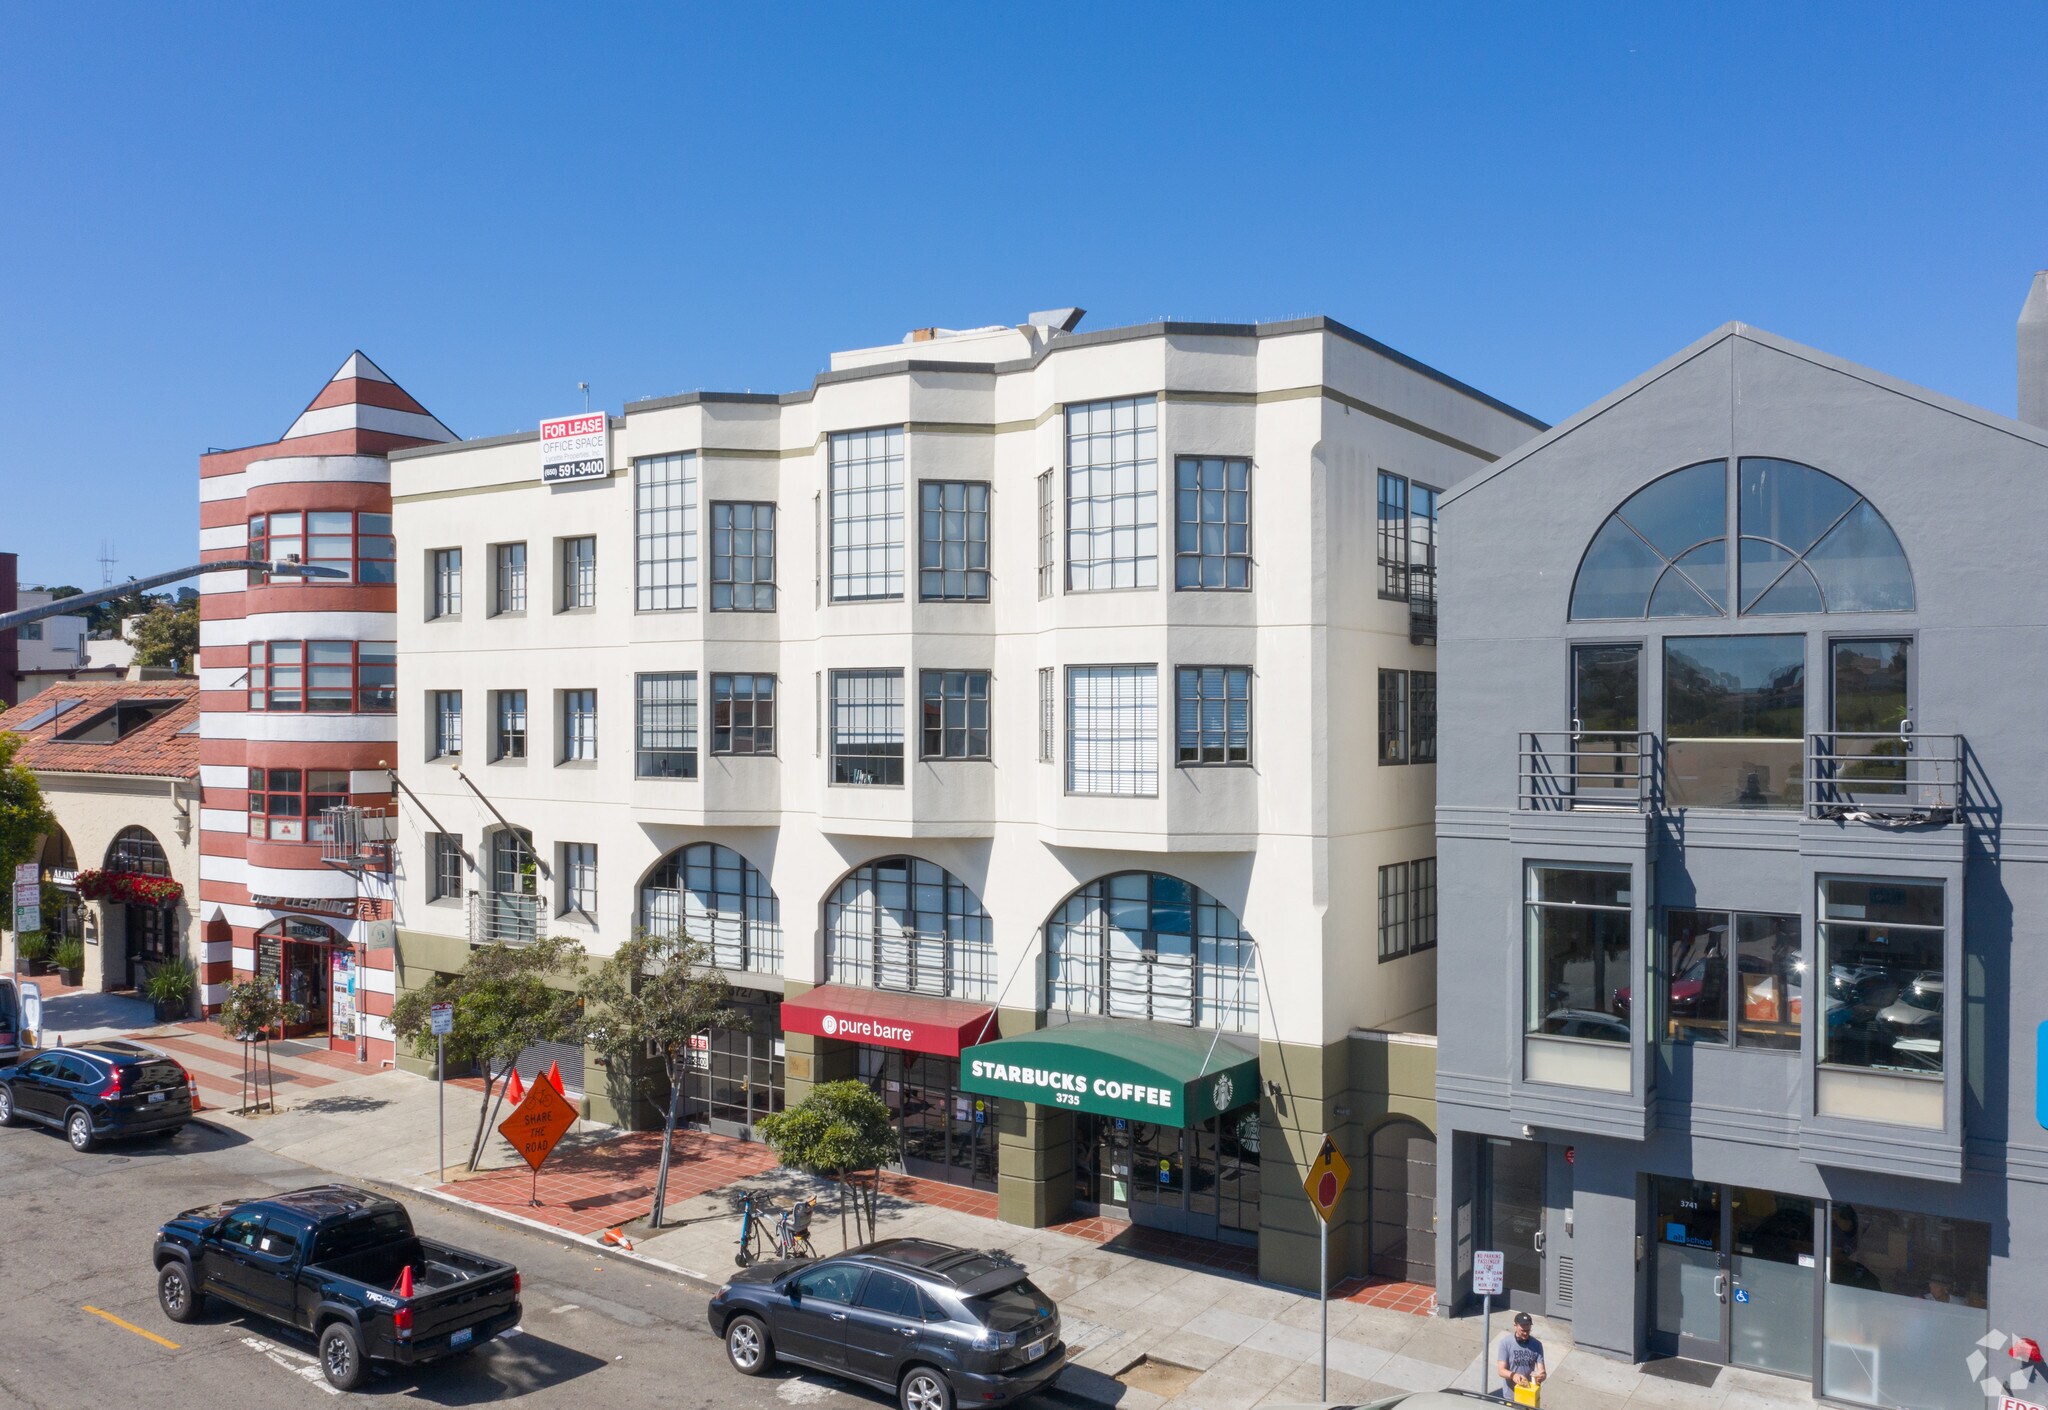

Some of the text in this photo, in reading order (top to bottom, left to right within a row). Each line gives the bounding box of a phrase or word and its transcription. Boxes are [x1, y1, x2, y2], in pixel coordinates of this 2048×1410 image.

[544, 418, 602, 438] FOR LEASE
[543, 436, 604, 454] OFFICE SPACE
[558, 460, 603, 477] 591-3400
[53, 868, 74, 880] ALAIN
[284, 897, 356, 916] CLEANING
[839, 1019, 871, 1035] pure
[873, 1020, 912, 1042] barre
[971, 1060, 1171, 1108] STARBUCKS COFFEE
[1055, 1092, 1080, 1106] 3735
[524, 1110, 552, 1126] SHARE
[530, 1126, 545, 1137] THE
[525, 1140, 549, 1153] ROAD
[1680, 1200, 1698, 1209] 3741
